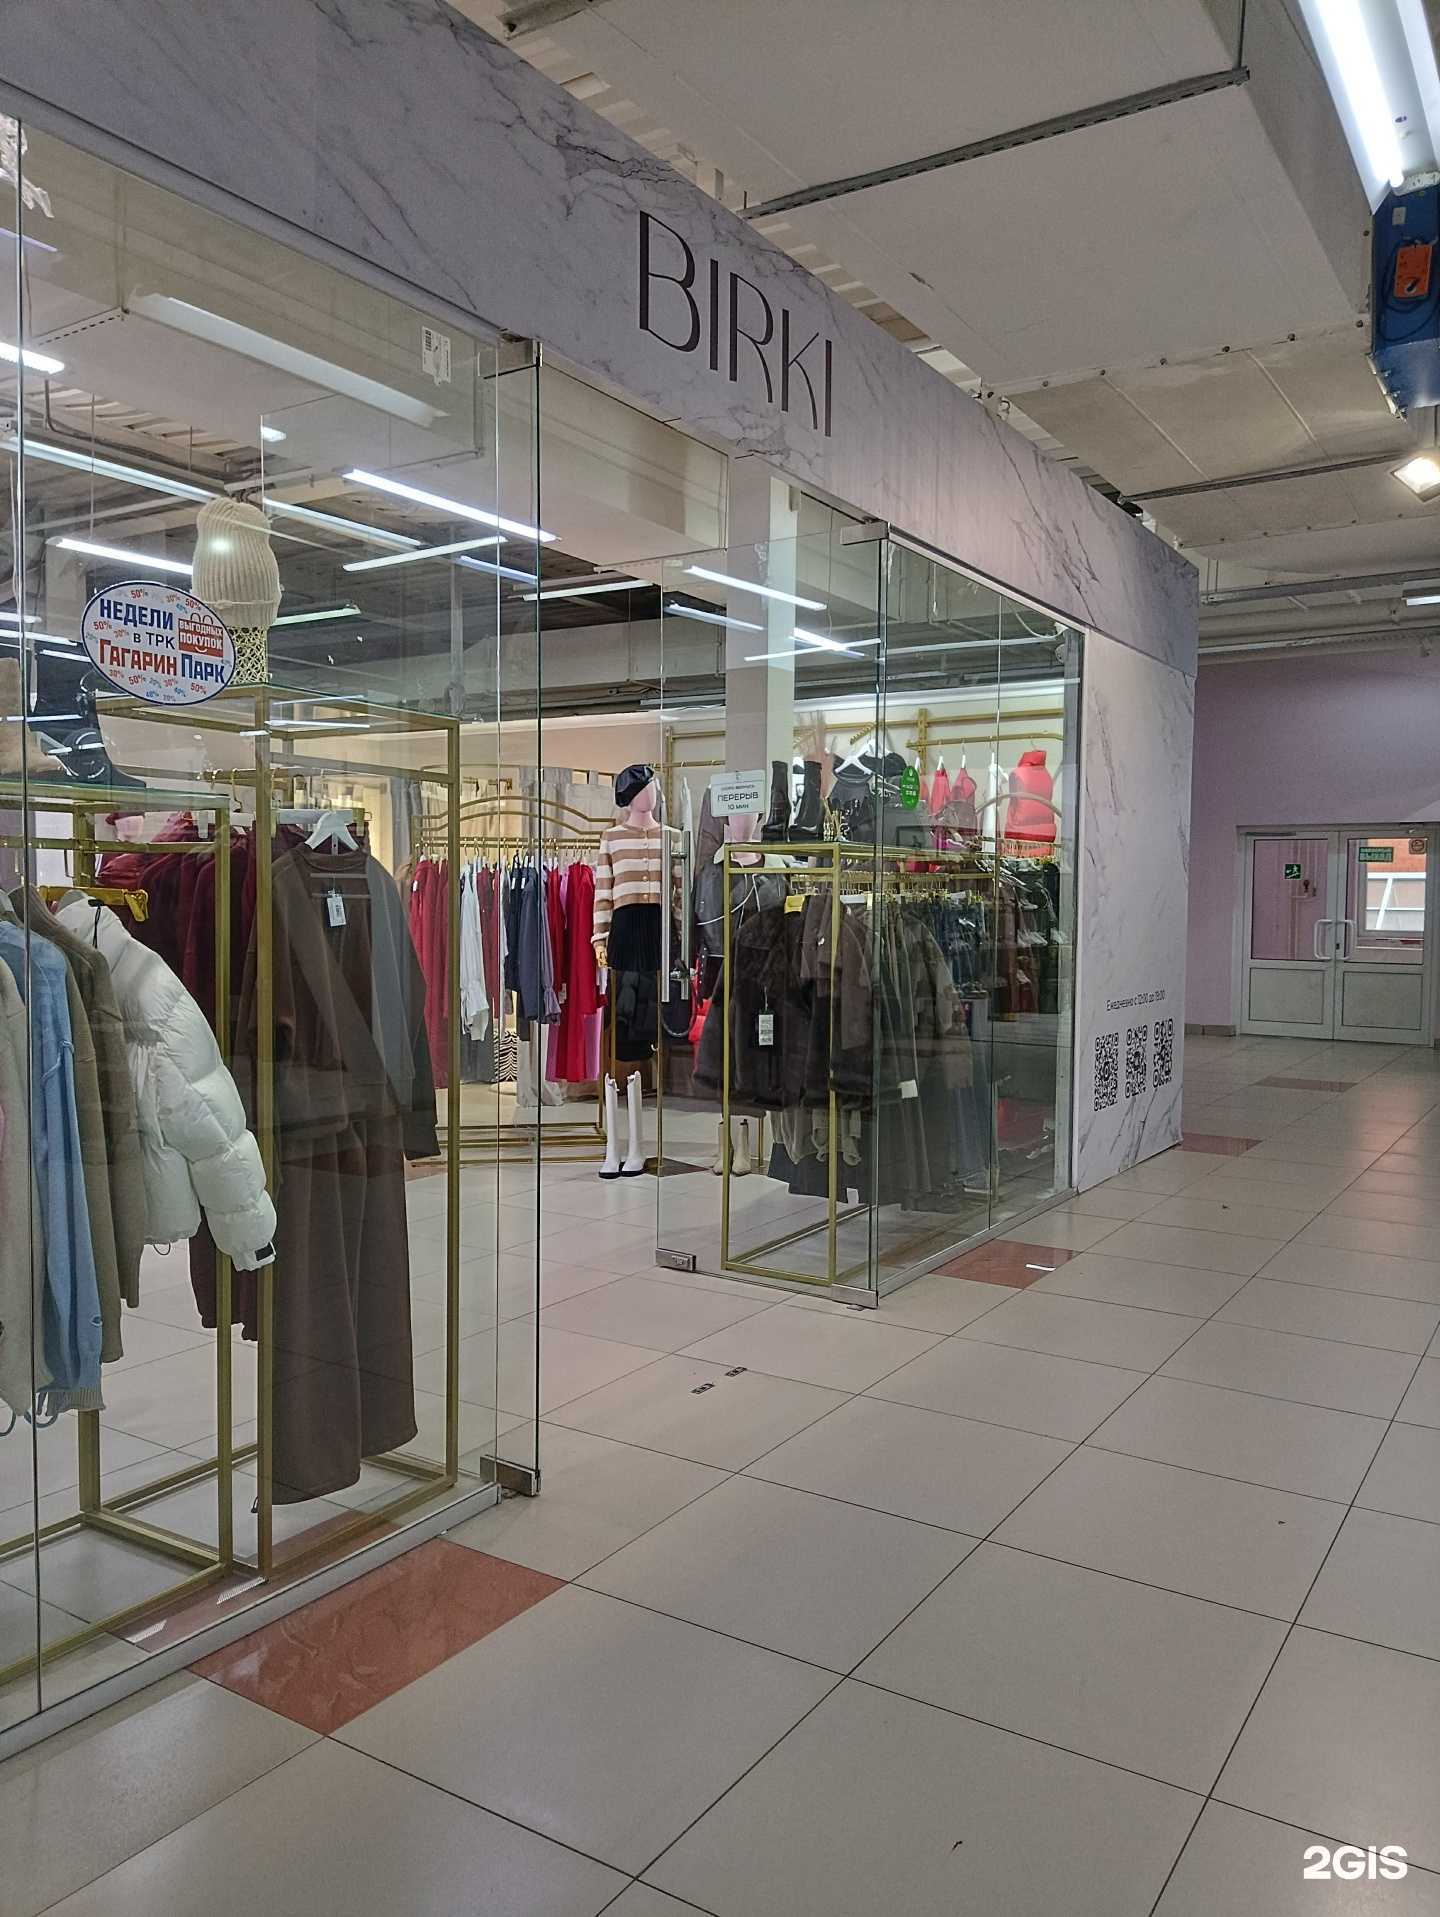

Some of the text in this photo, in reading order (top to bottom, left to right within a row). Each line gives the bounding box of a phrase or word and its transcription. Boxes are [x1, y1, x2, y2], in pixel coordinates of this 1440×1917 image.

[640, 210, 832, 437] BIRKI
[100, 598, 173, 631] НЕДЕЛИ
[179, 620, 222, 637] ВЫГОДНЫХ
[145, 631, 176, 650] ТРК
[179, 632, 222, 650] ПОКУПОК
[100, 638, 225, 684] ГАГАРИН ПАРК
[190, 683, 207, 695] 50%
[717, 791, 759, 802] ПЕРЕРЫВ
